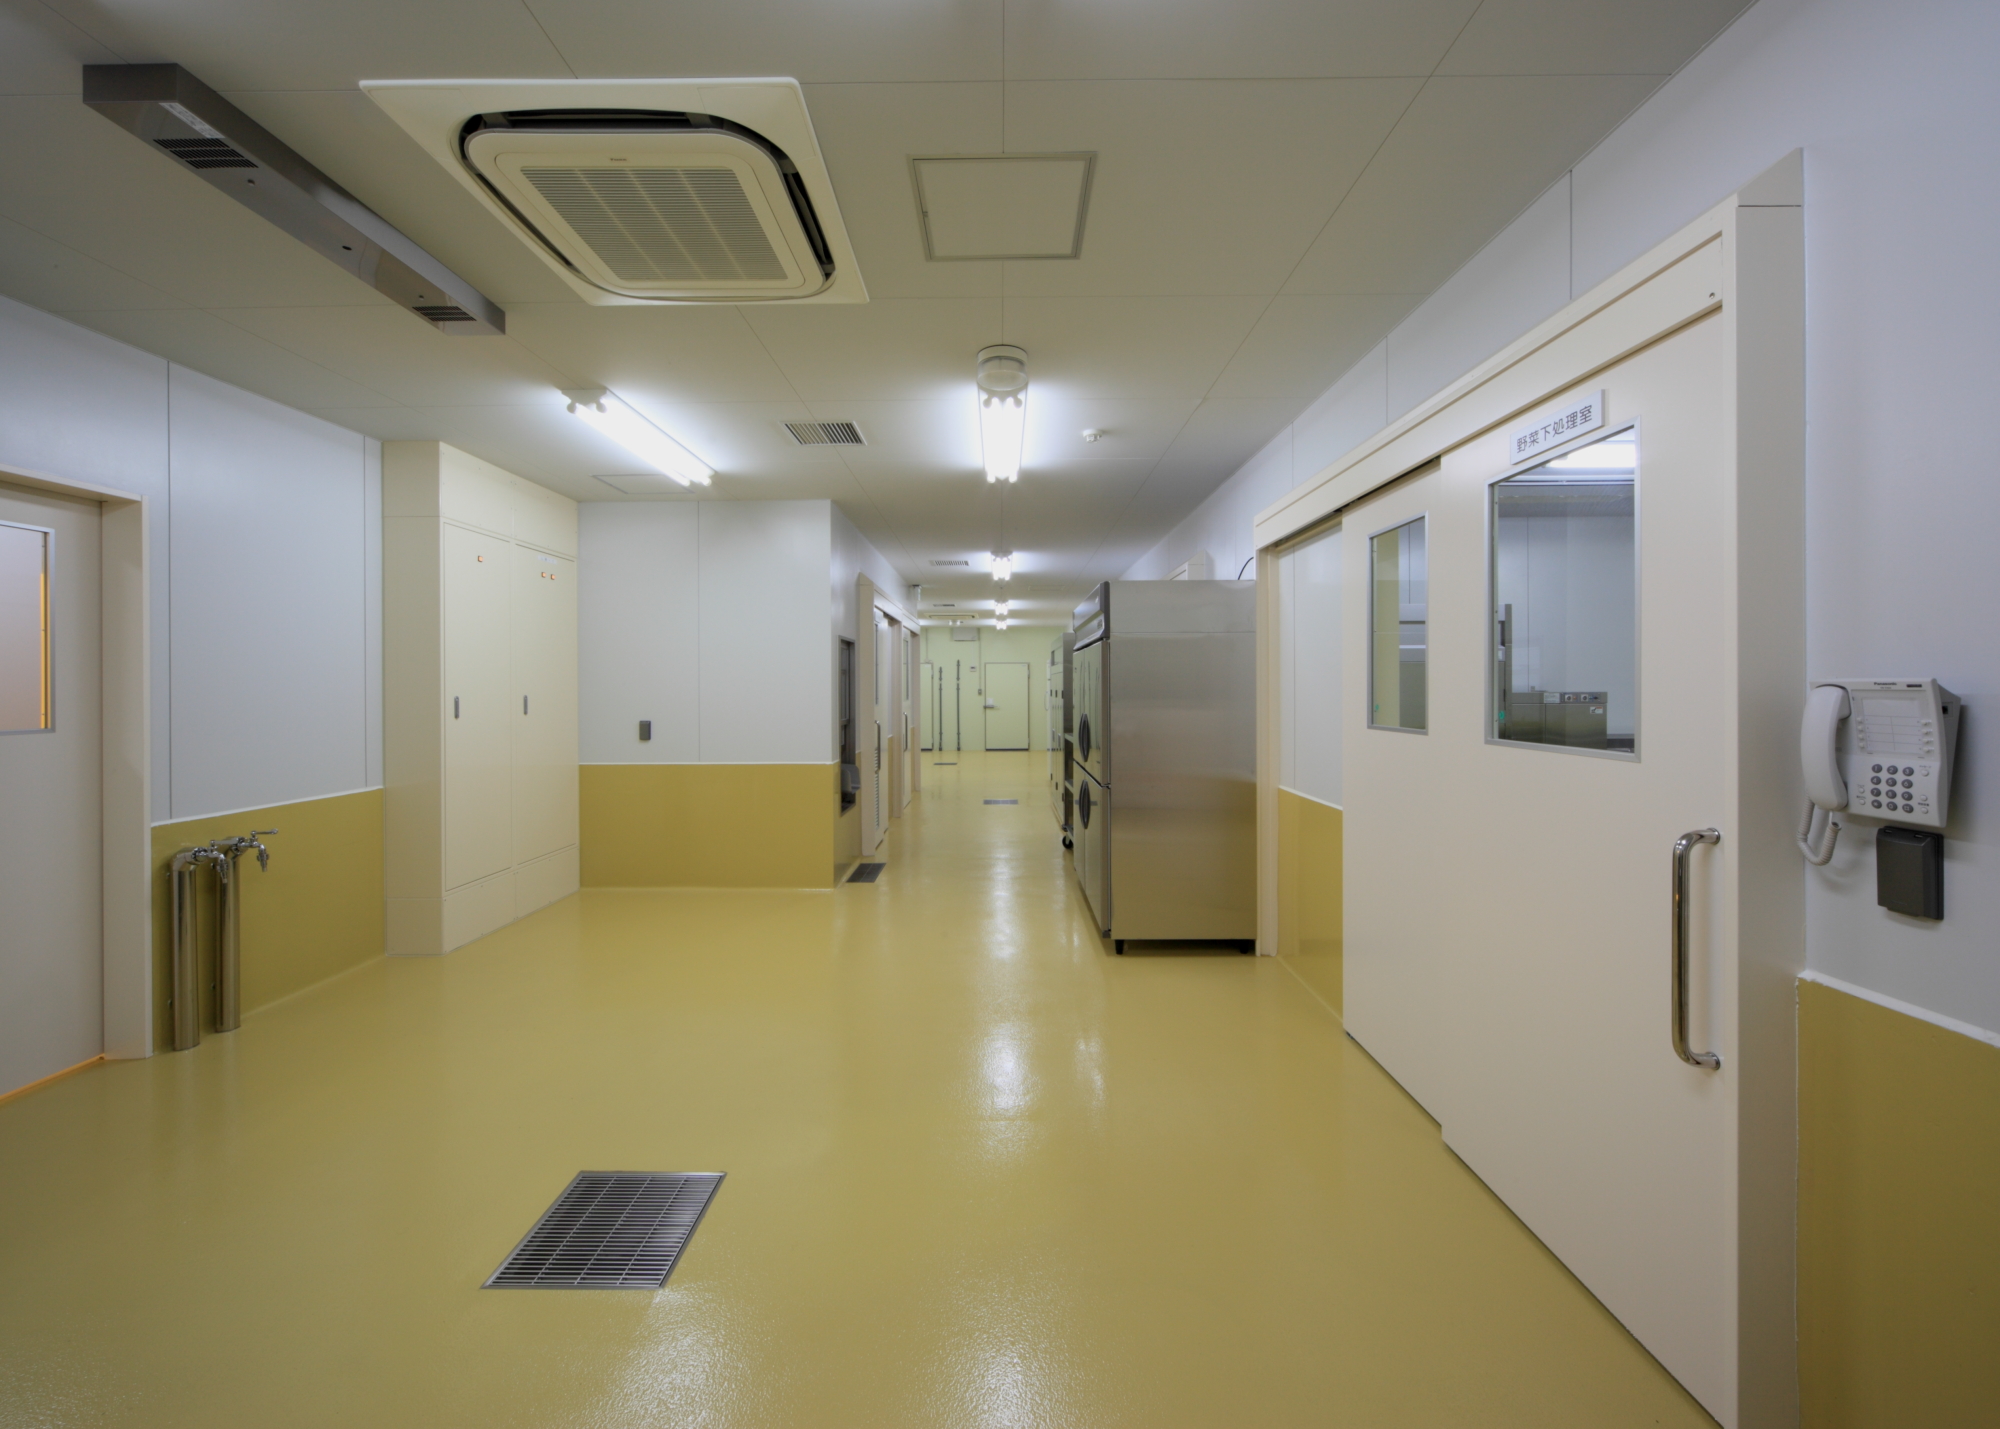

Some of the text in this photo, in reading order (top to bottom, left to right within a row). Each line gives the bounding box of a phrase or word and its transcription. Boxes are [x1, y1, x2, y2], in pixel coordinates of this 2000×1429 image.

[1516, 404, 1593, 454] 野菜下処理室
